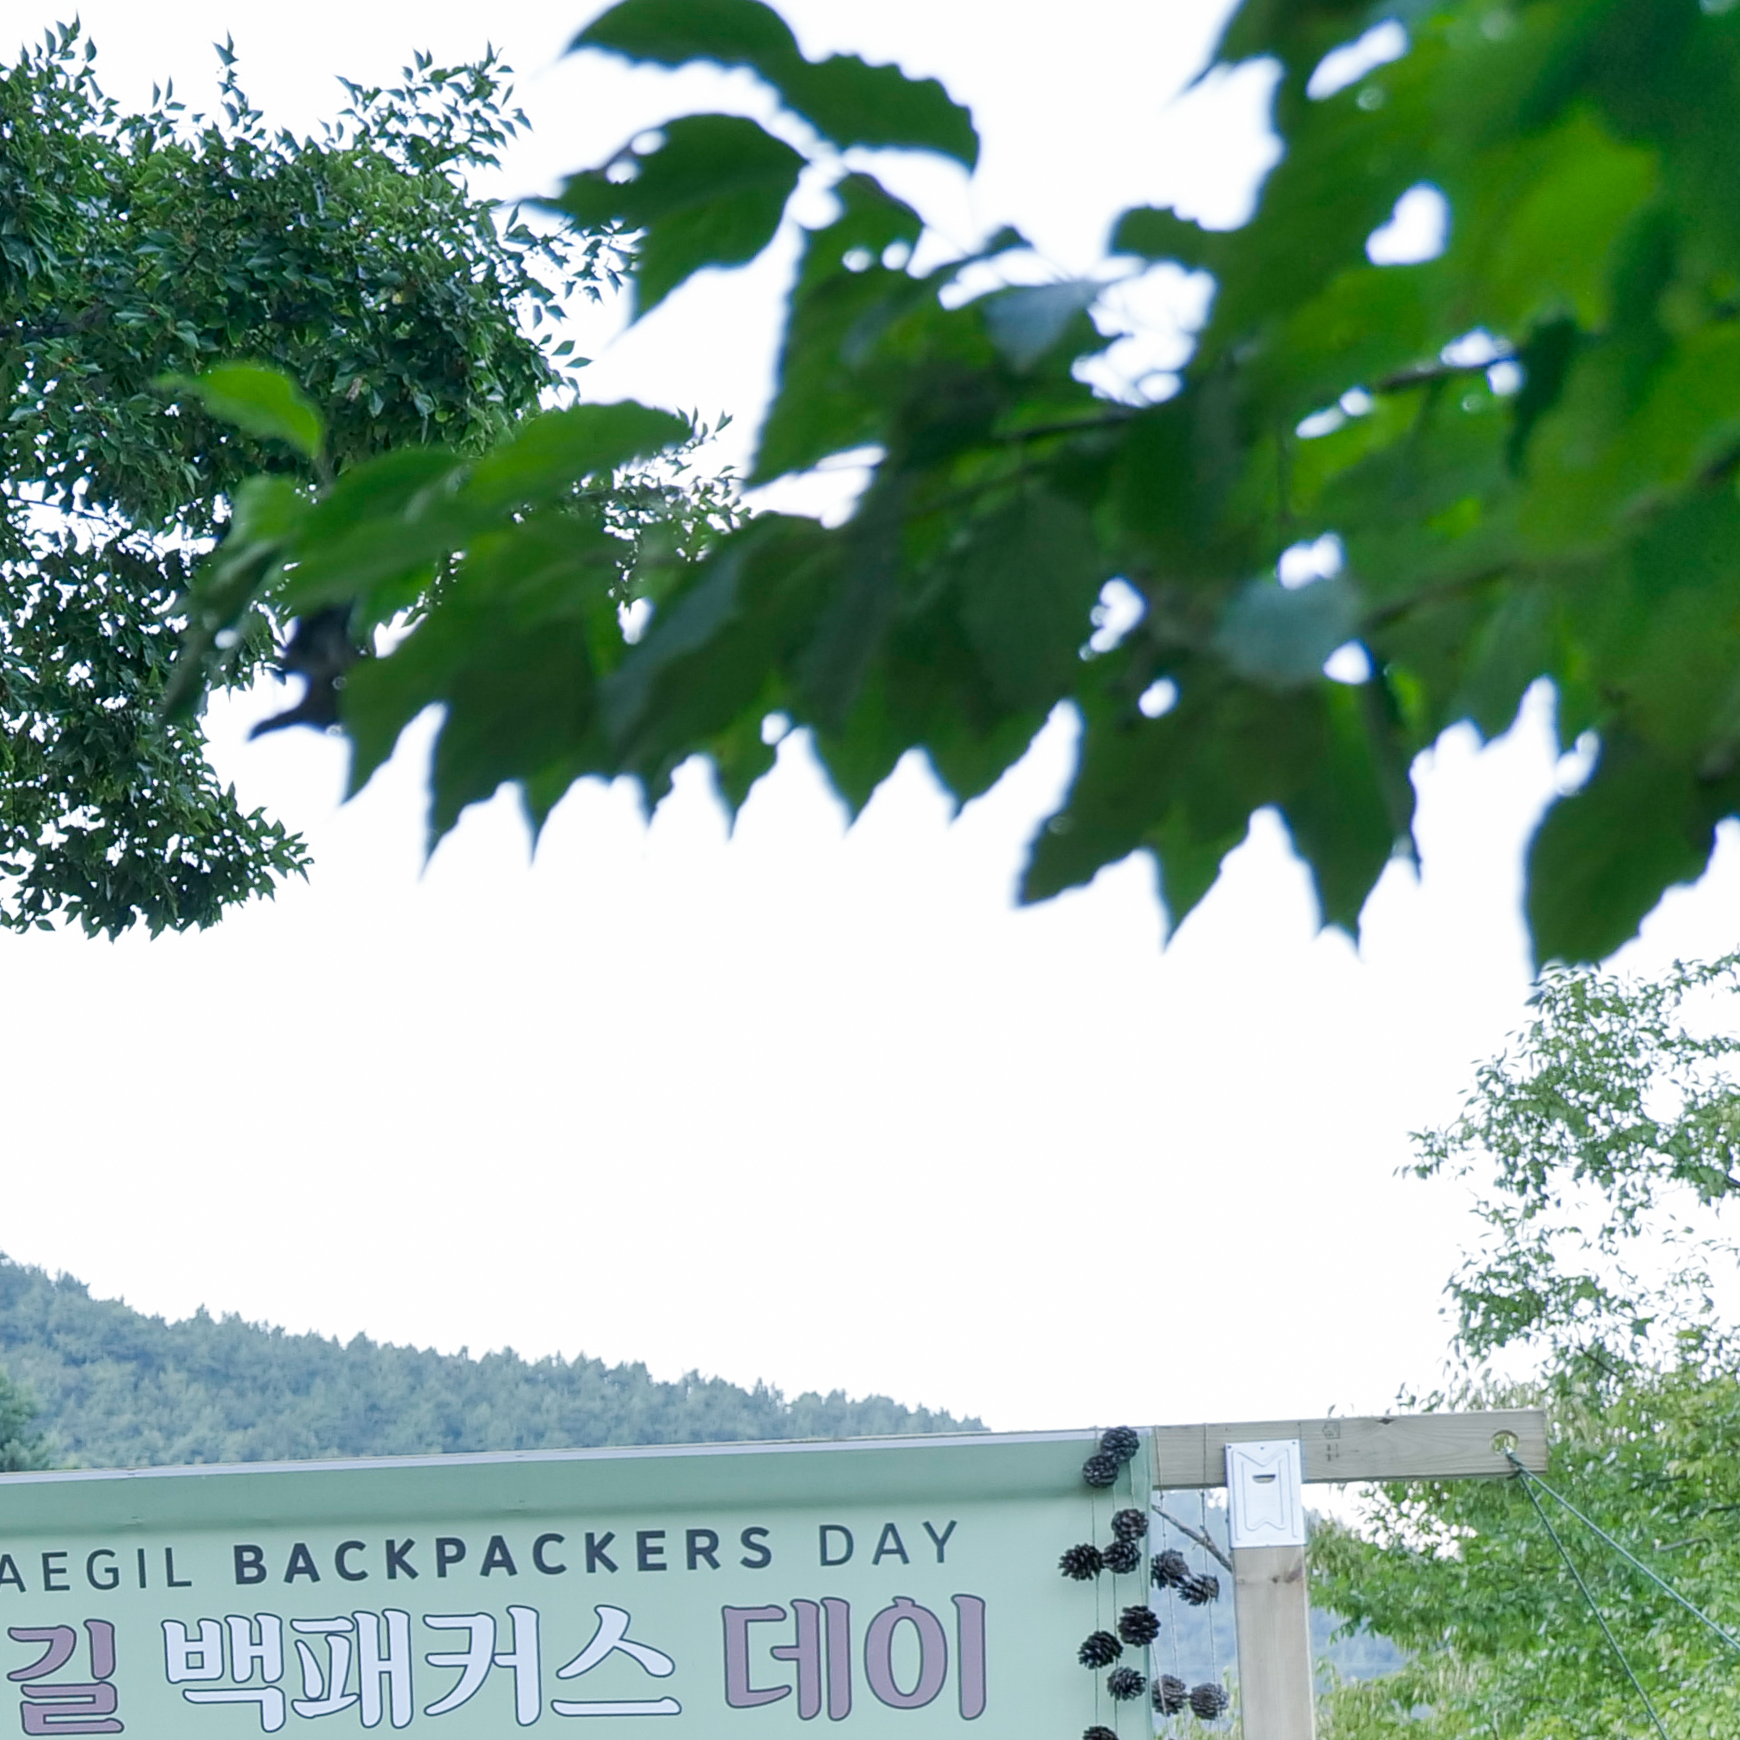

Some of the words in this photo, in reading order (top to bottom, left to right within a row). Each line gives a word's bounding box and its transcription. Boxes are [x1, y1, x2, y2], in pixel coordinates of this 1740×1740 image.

[233, 1525, 773, 1586] BACKPACKERS
[818, 1518, 959, 1567] DAY
[160, 1603, 683, 1734] 백패커스
[721, 1593, 988, 1723] 데이
